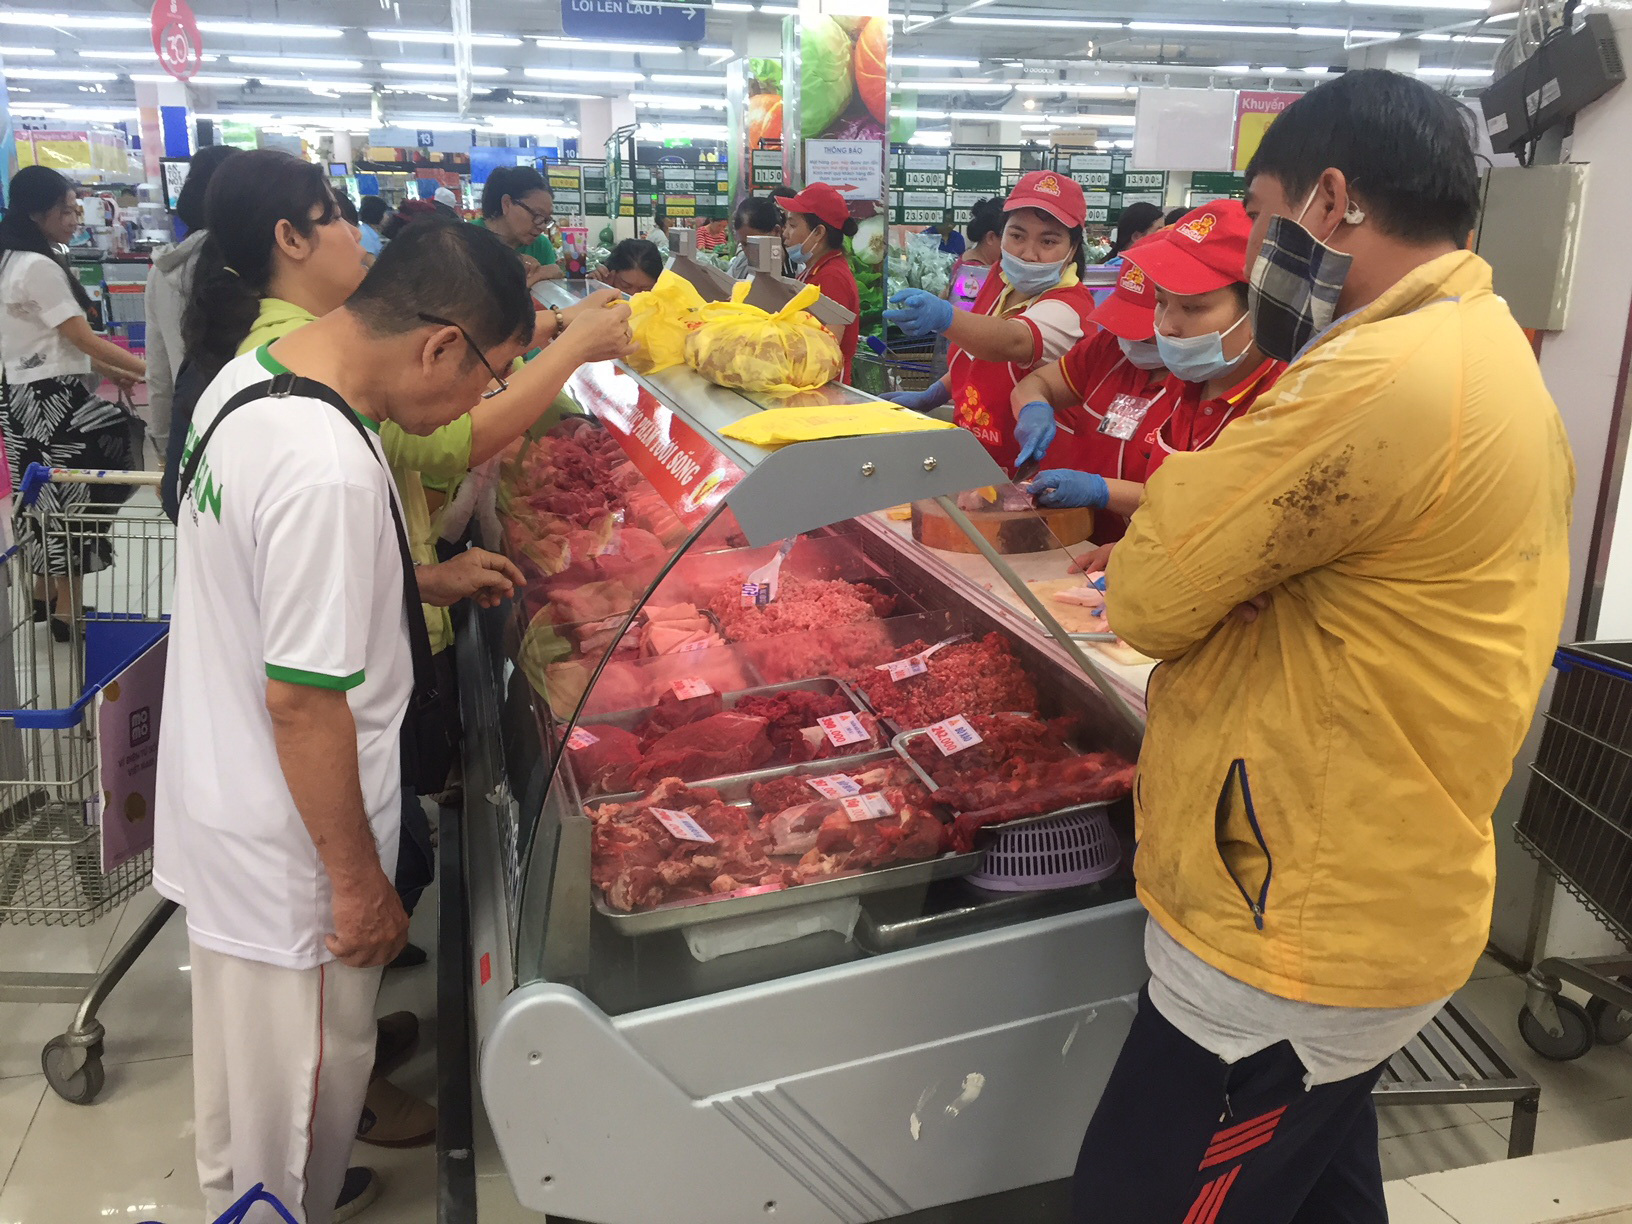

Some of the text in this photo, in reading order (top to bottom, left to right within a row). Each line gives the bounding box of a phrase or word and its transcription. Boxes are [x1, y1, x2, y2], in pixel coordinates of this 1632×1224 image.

[167, 33, 187, 65] 30
[1242, 97, 1285, 112] Khuyến
[419, 132, 431, 144] 13
[565, 149, 575, 158] 10
[906, 174, 938, 183] 10.500
[1127, 175, 1156, 184] 13.900
[905, 211, 937, 221] 23.500
